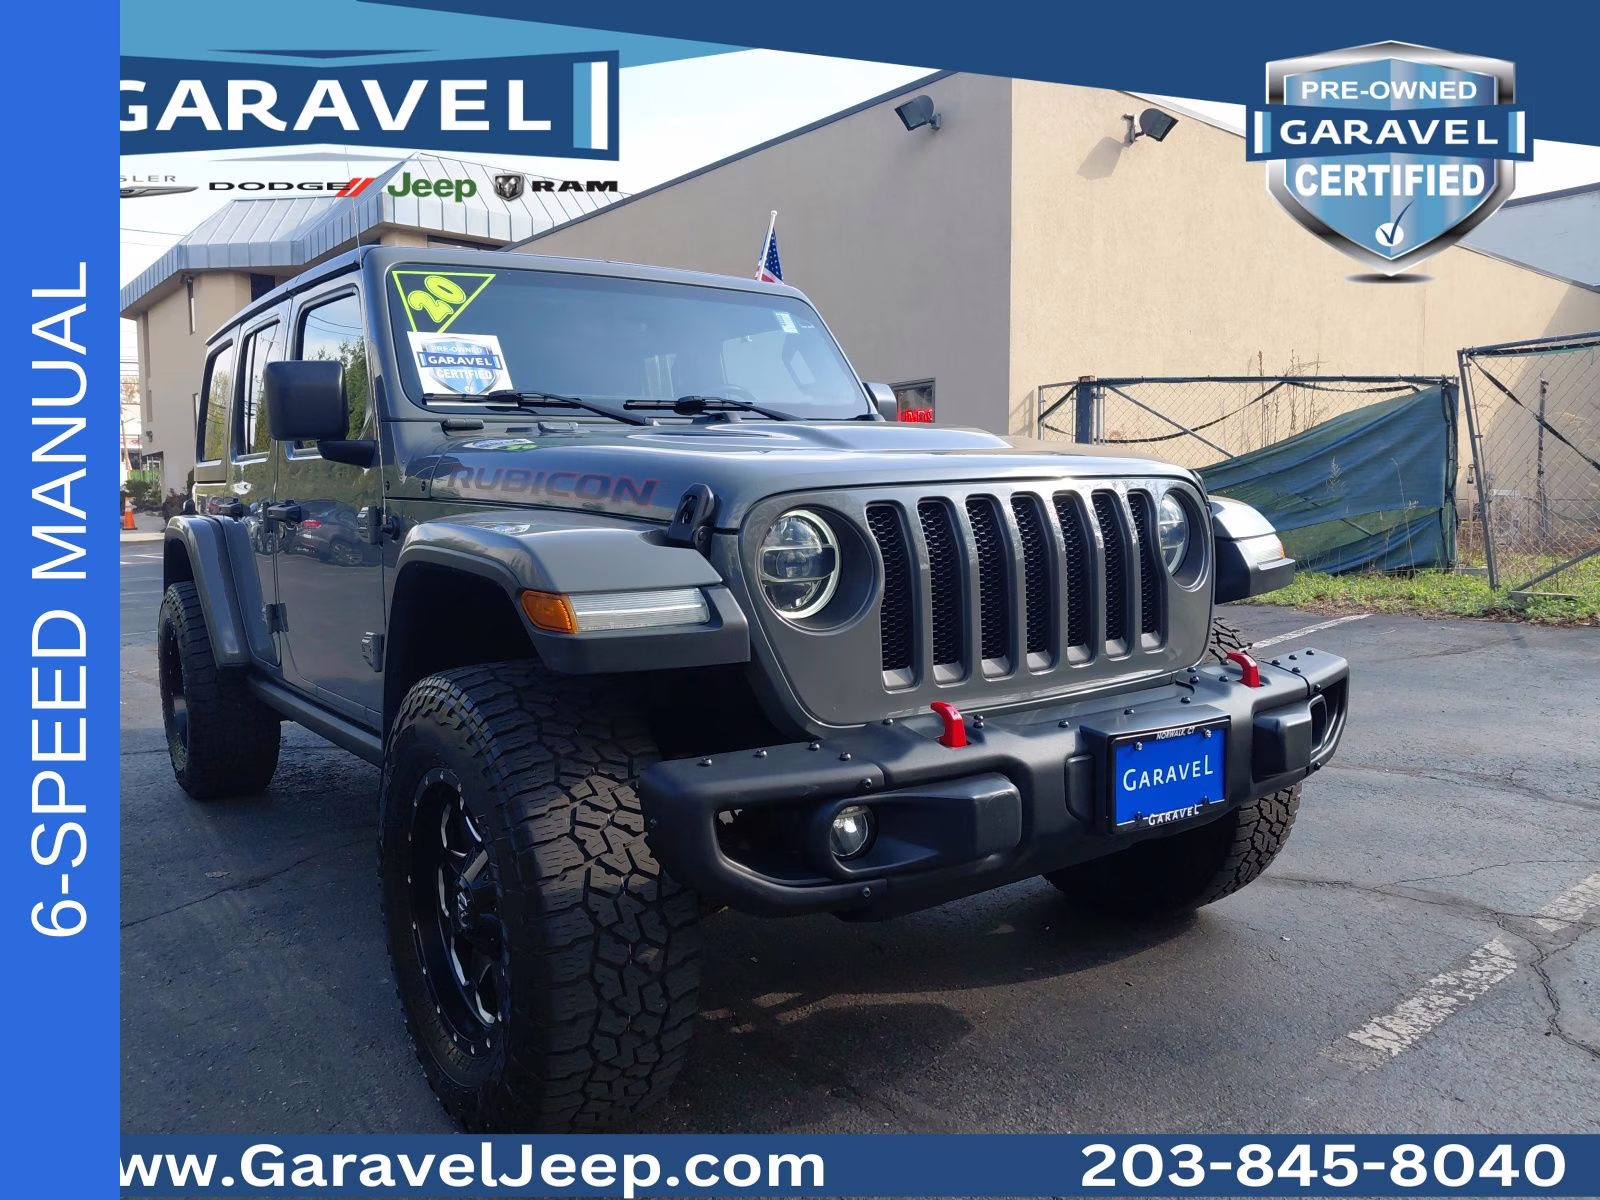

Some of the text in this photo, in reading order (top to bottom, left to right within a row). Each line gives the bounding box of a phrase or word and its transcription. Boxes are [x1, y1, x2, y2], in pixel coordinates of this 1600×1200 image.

[408, 275, 466, 323] 20
[428, 356, 493, 366] GARAVEL
[436, 368, 493, 379] CERTIFIED
[448, 464, 660, 507] RUBICON
[1156, 728, 1185, 740] NORWALK
[1123, 755, 1213, 791] GARAVEL
[1148, 803, 1200, 826] GARAVEL
